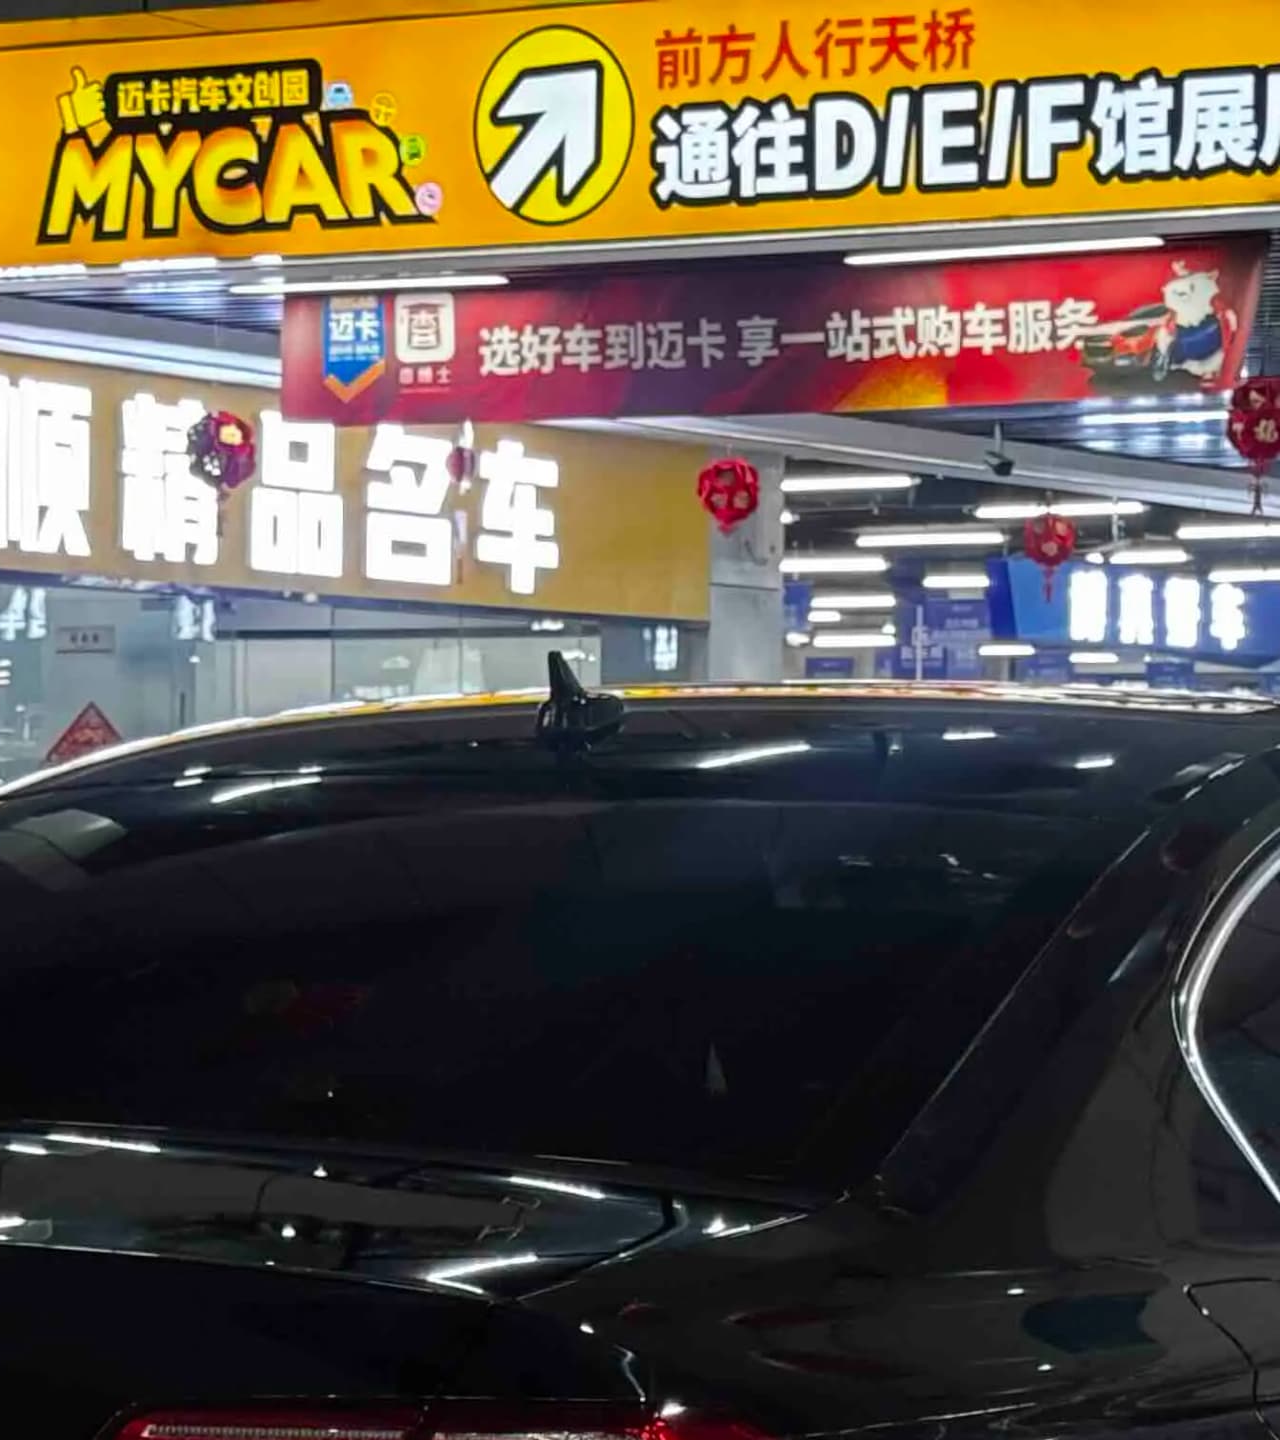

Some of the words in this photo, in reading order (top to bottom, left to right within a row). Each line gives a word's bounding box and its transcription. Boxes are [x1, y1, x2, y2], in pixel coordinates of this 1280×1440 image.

[656, 9, 975, 88] 前方人行天桥
[117, 68, 310, 118] 迈卡汽车文创园
[41, 118, 426, 240] MYCAR
[479, 318, 726, 377] 选好车到迈卡
[737, 298, 1099, 368] 享一站式购车服务
